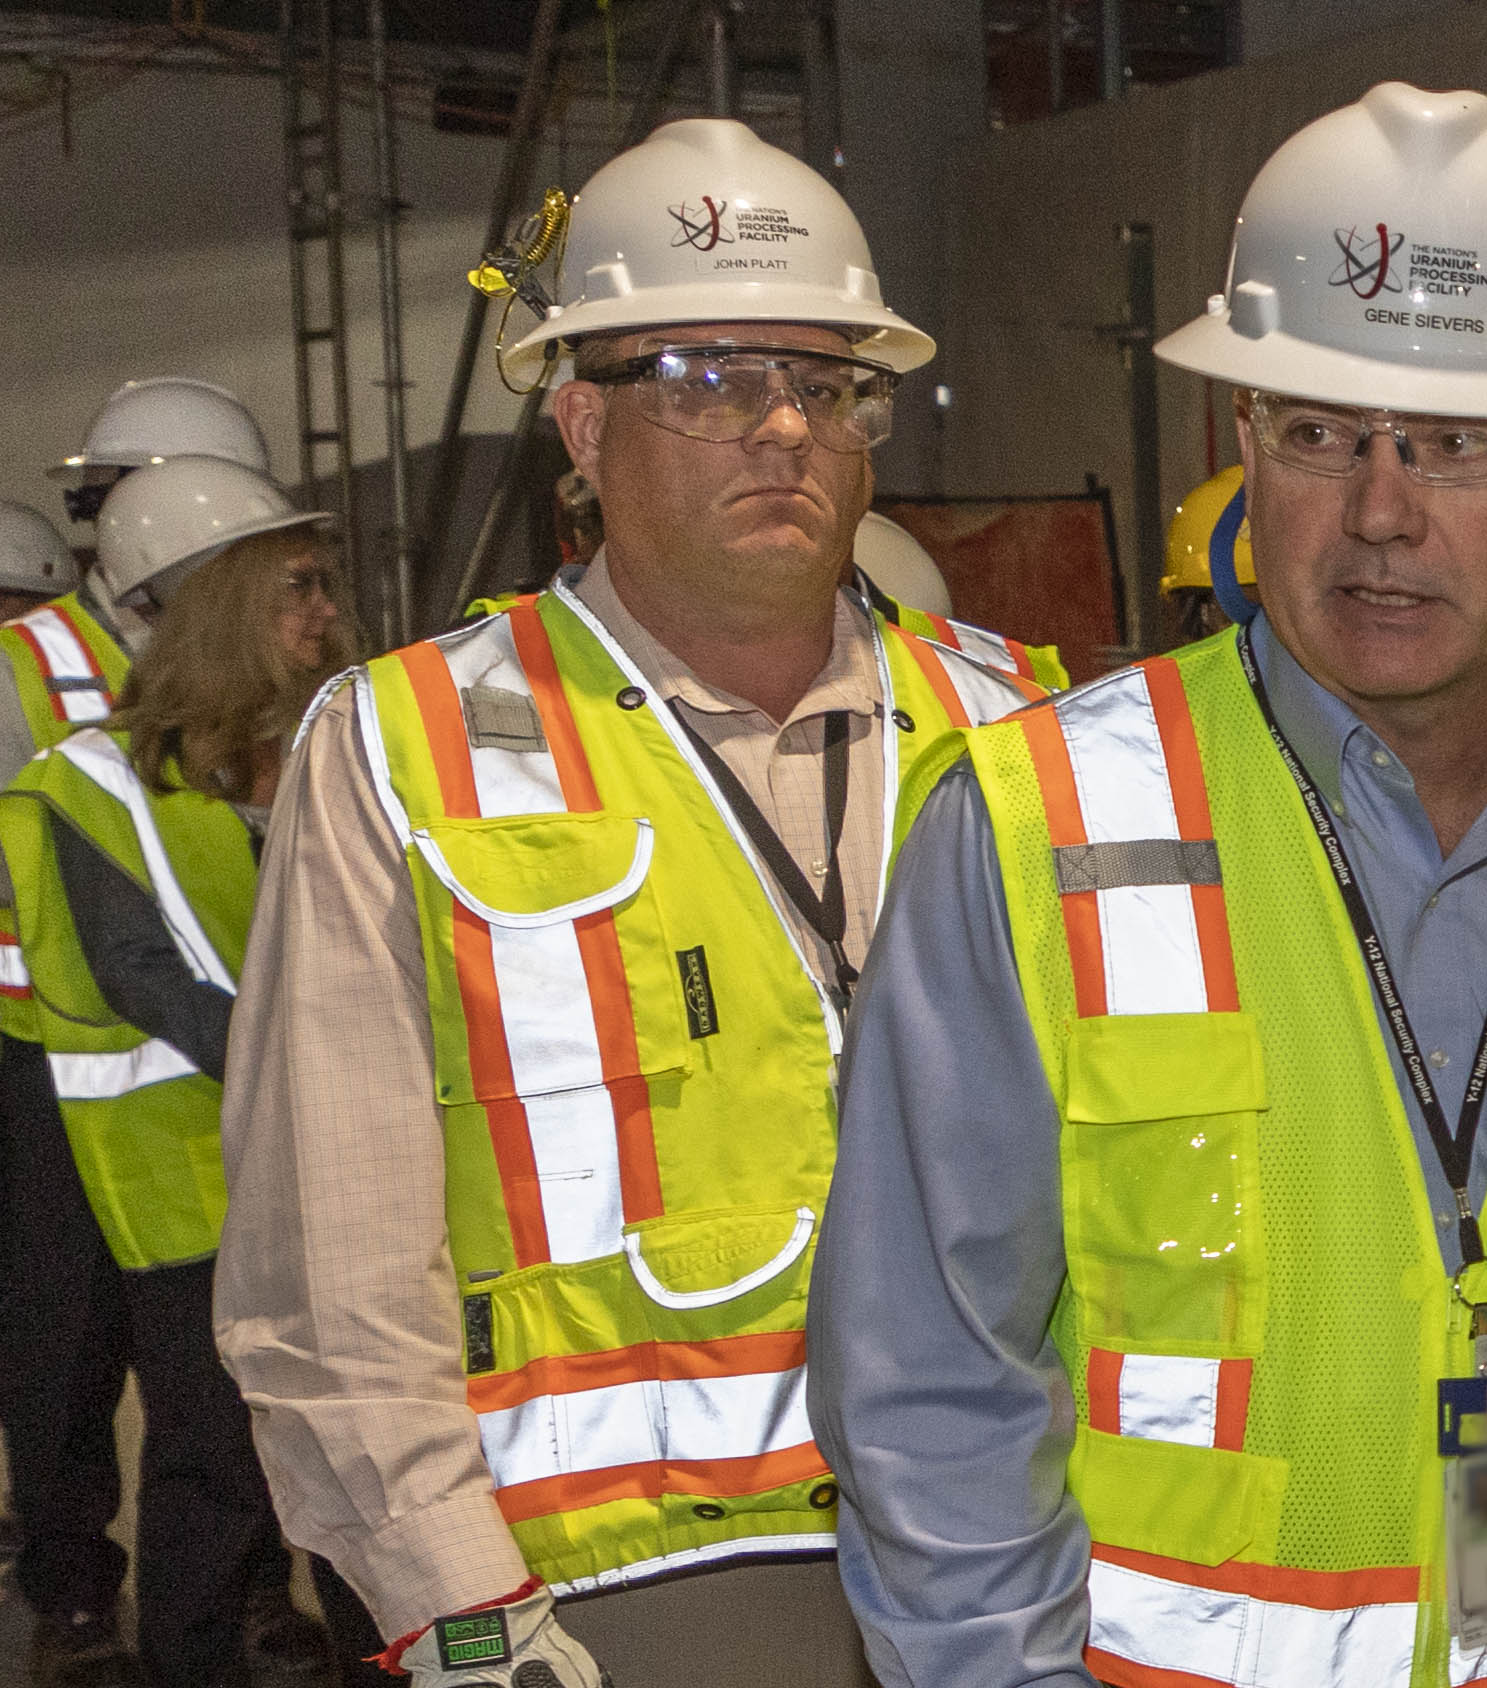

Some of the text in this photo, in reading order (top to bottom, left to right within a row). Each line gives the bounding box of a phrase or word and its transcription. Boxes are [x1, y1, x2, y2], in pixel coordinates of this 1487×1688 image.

[736, 213, 789, 224] URANIUM
[737, 222, 809, 236] PROCESSING
[739, 232, 788, 242] FACILITY
[1412, 244, 1478, 258] THE NATION'S
[714, 259, 788, 270] JOHN PLATT
[1410, 253, 1478, 271] URANIUM
[1364, 308, 1485, 334] GENE SIEVERS
[1282, 748, 1309, 792] National
[1304, 790, 1330, 836] Security
[1324, 835, 1352, 887] Complex
[1364, 935, 1434, 1104] Y-12 National Security Complex
[1466, 1079, 1484, 1103] Y-12
